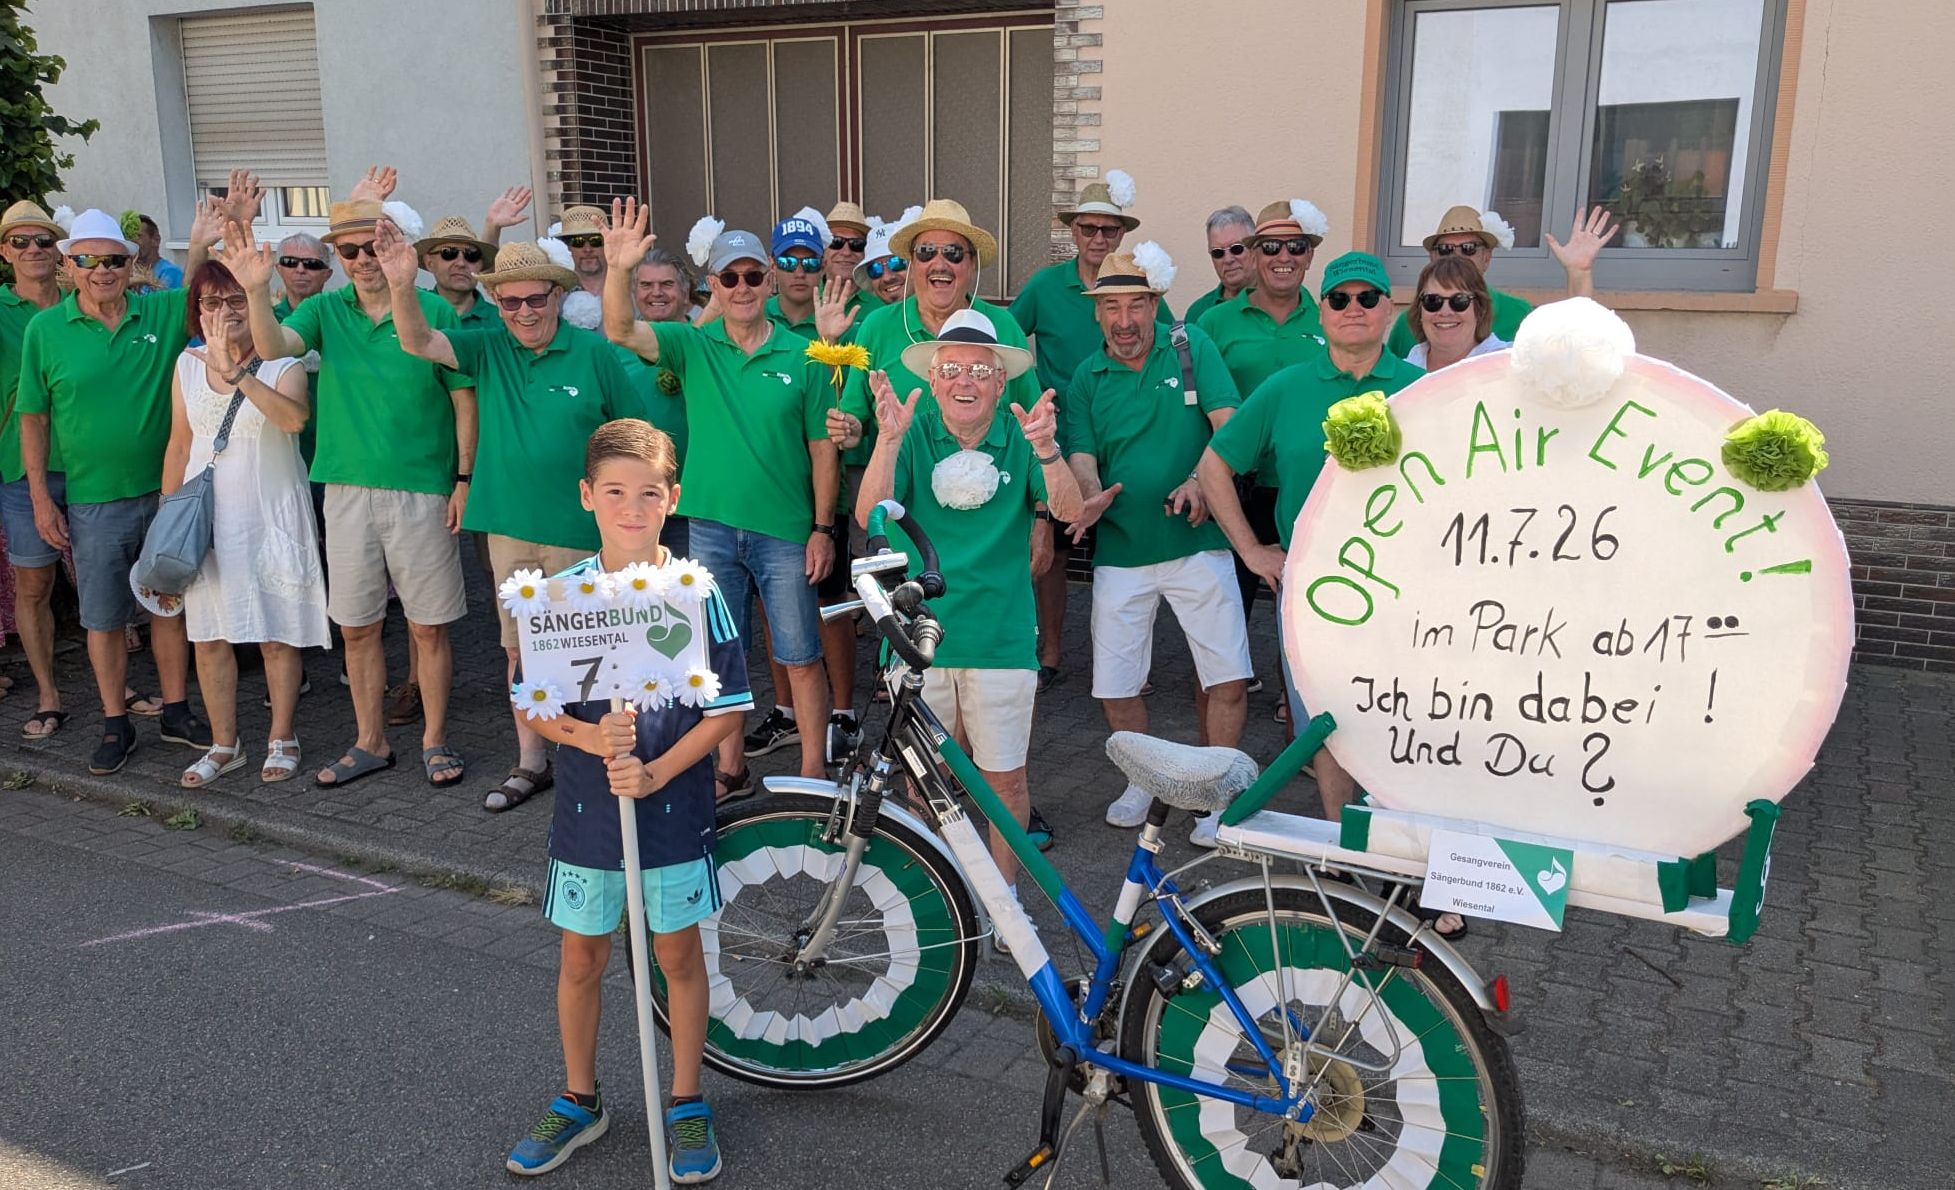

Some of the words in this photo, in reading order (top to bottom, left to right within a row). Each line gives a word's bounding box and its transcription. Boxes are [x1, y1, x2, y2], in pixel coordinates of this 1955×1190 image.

[782, 220, 814, 236] 1894
[1305, 449, 1447, 627] Open
[1466, 399, 1560, 479] Air
[1440, 504, 1620, 569] 11.7.26
[530, 604, 662, 635] SÄNGERBUND
[1412, 613, 1454, 649] im
[1469, 600, 1567, 661] Park
[1592, 617, 1634, 657] ab
[571, 656, 603, 702] 7
[1352, 676, 1409, 723] Ich
[1427, 677, 1493, 721] bin
[1518, 671, 1661, 724] dabei
[1388, 725, 1462, 766] Und
[1485, 732, 1554, 777] Du
[1430, 871, 1483, 888] Sängerbund
[1486, 882, 1506, 893] 1862
[1508, 886, 1524, 896] e.V.
[1450, 852, 1511, 870] Gesangverein
[1452, 897, 1495, 913] Wiesental
